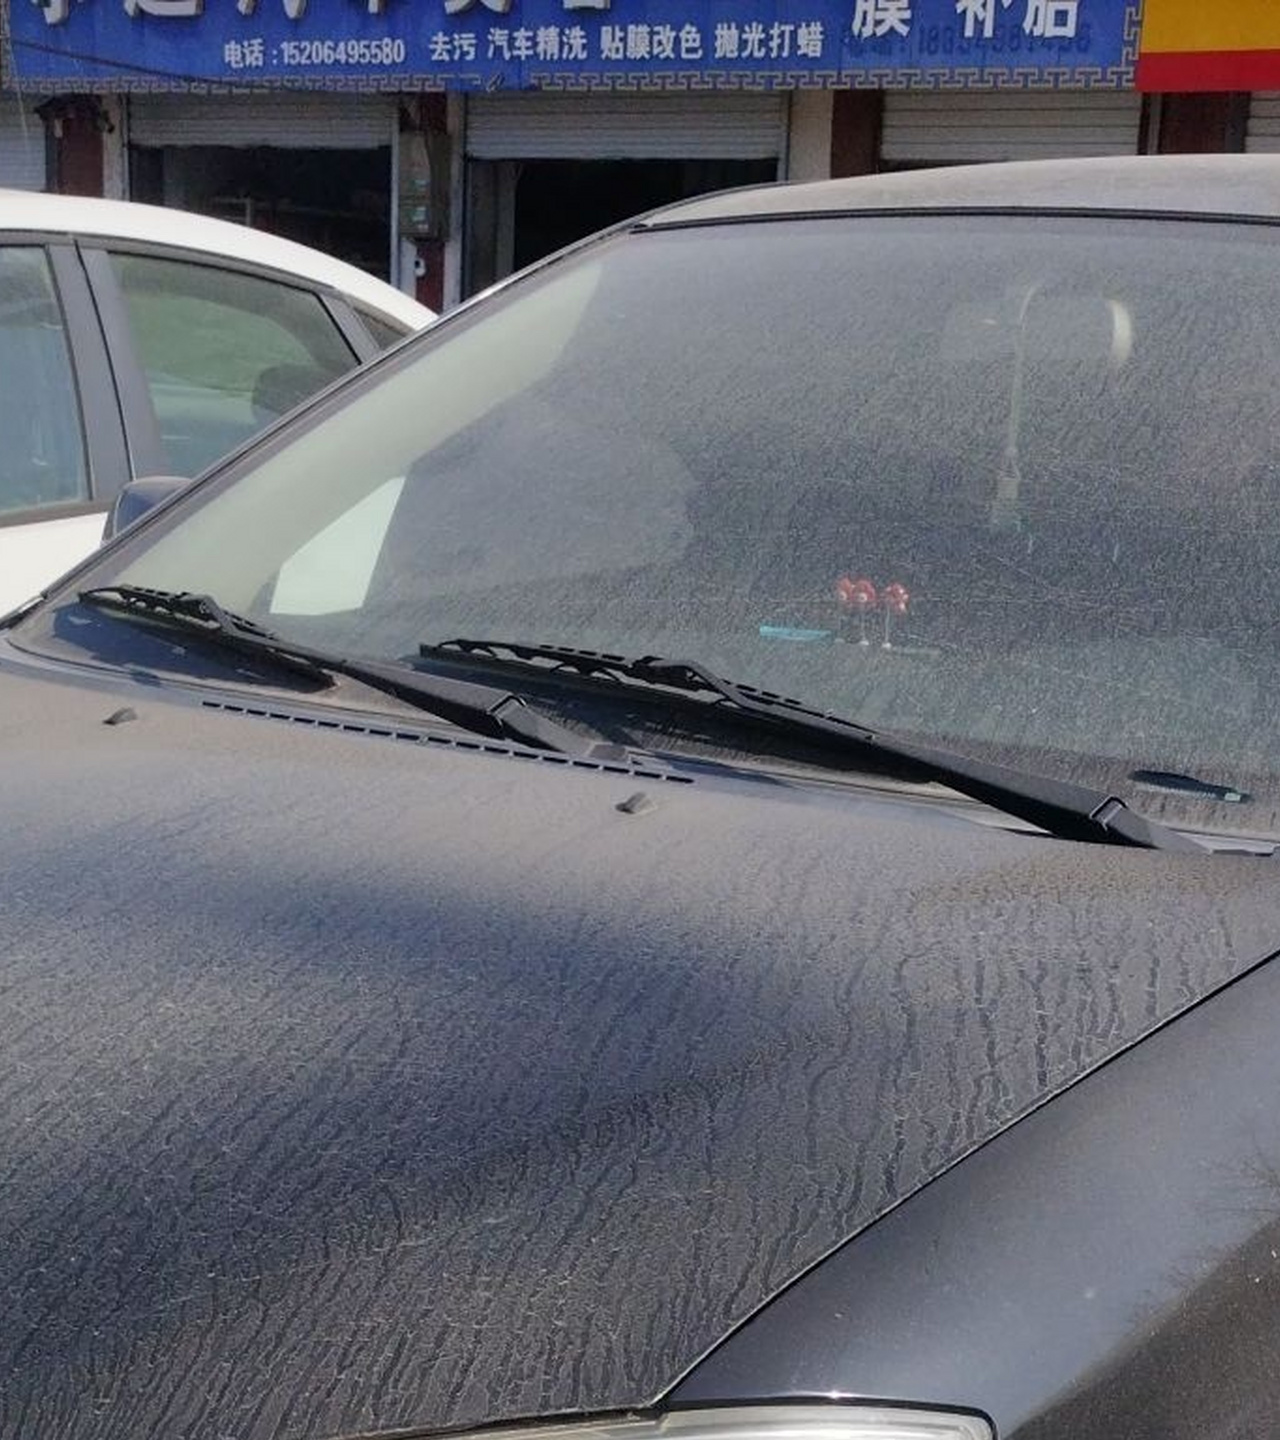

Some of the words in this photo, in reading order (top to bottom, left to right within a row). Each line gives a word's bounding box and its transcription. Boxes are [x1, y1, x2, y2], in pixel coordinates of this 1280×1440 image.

[429, 31, 477, 61] 去污
[487, 26, 588, 60] 汽车精洗
[600, 23, 703, 59] 贴膜改色
[714, 22, 824, 58] 抛光打蜡
